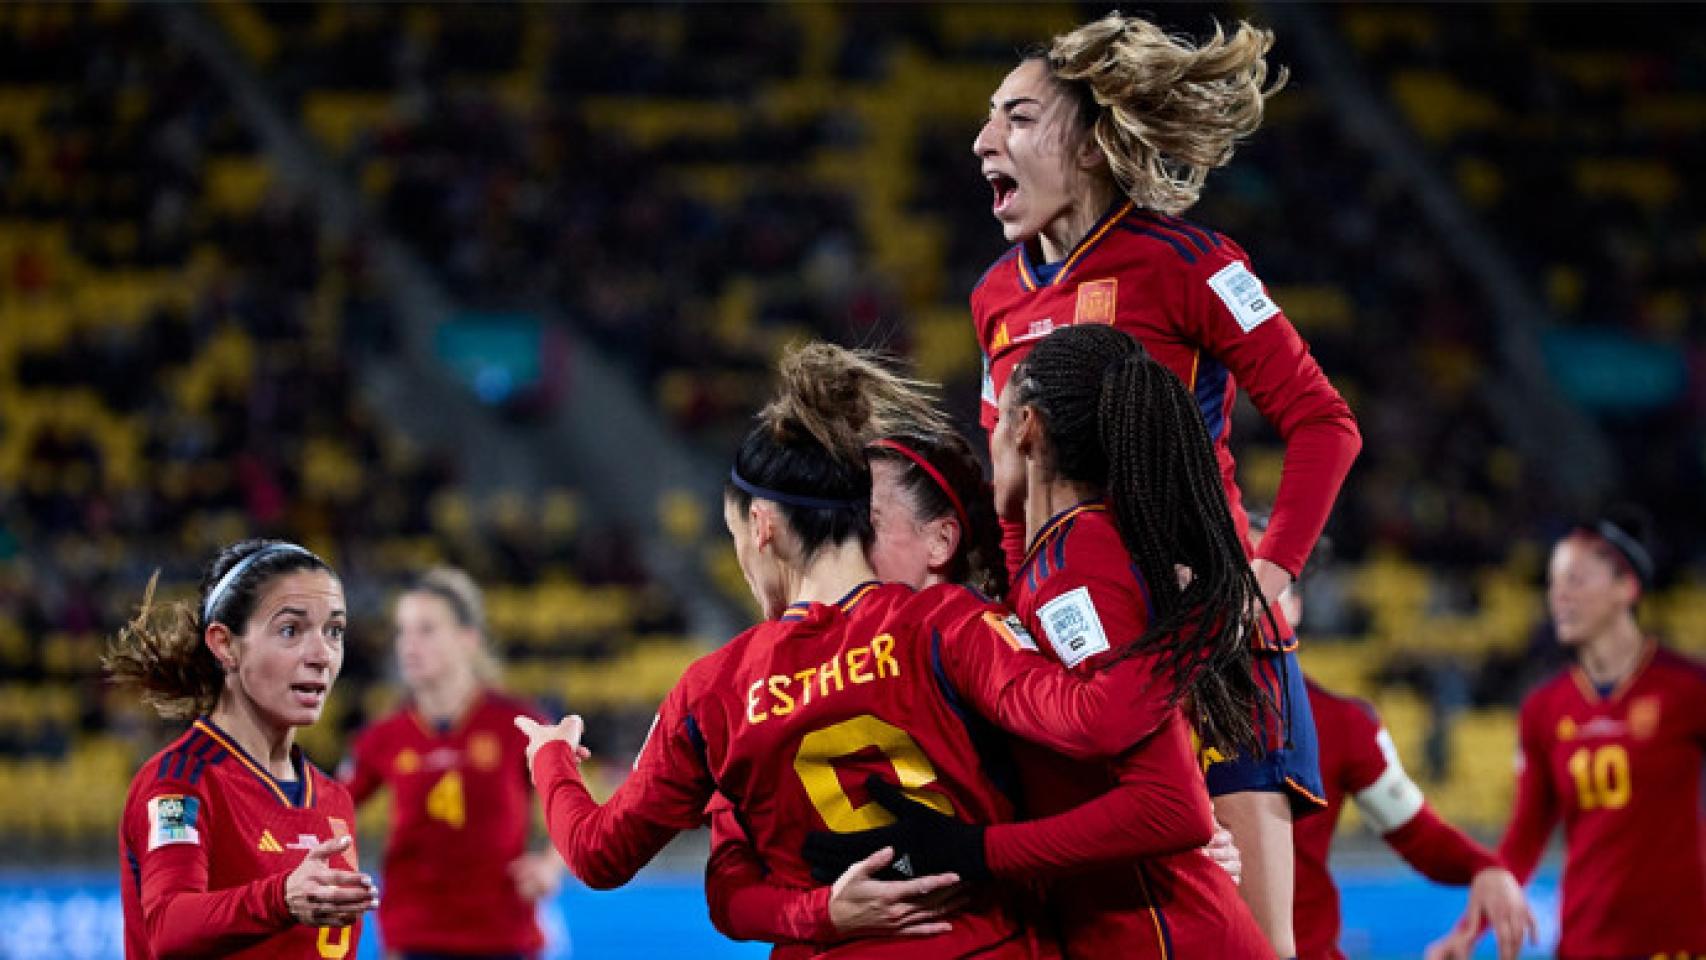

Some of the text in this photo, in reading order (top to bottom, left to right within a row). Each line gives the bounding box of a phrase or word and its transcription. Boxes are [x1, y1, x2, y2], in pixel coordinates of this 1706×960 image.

[748, 633, 900, 724] ESTHER
[426, 771, 466, 828] 4
[1569, 744, 1633, 810] 10
